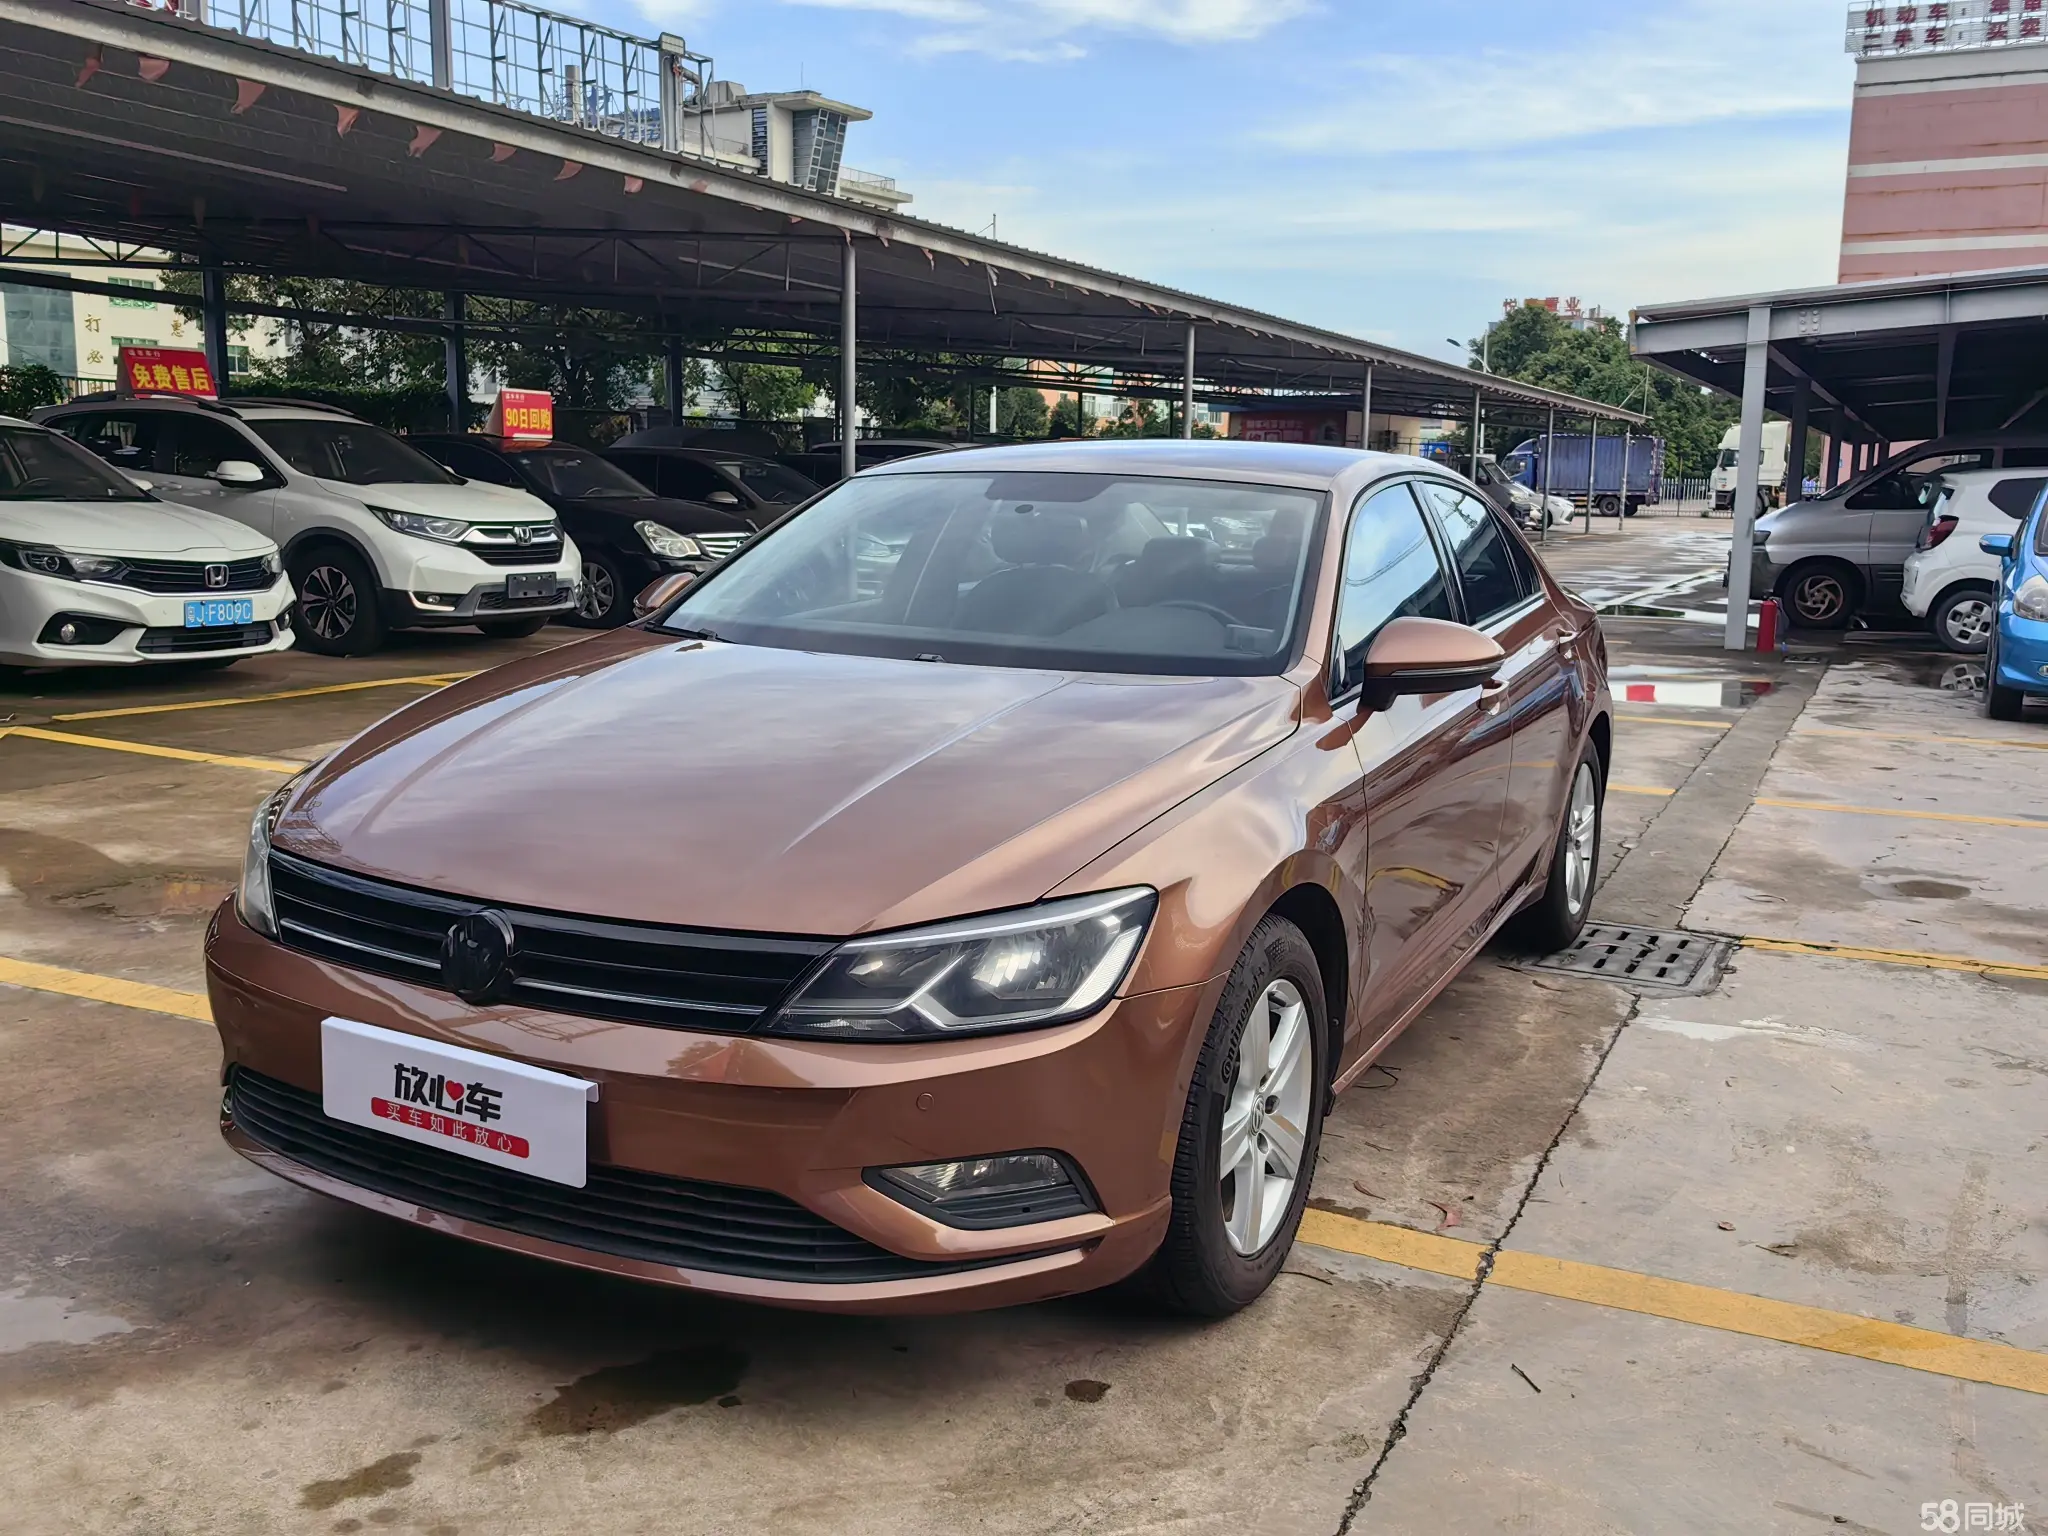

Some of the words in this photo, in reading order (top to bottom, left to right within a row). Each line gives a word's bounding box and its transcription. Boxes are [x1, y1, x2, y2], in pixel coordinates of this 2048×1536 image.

[132, 363, 210, 391] 免费售后
[505, 407, 551, 431] 90日回购
[394, 1062, 503, 1123] 放心车
[386, 1104, 513, 1153] 买车如此放心
